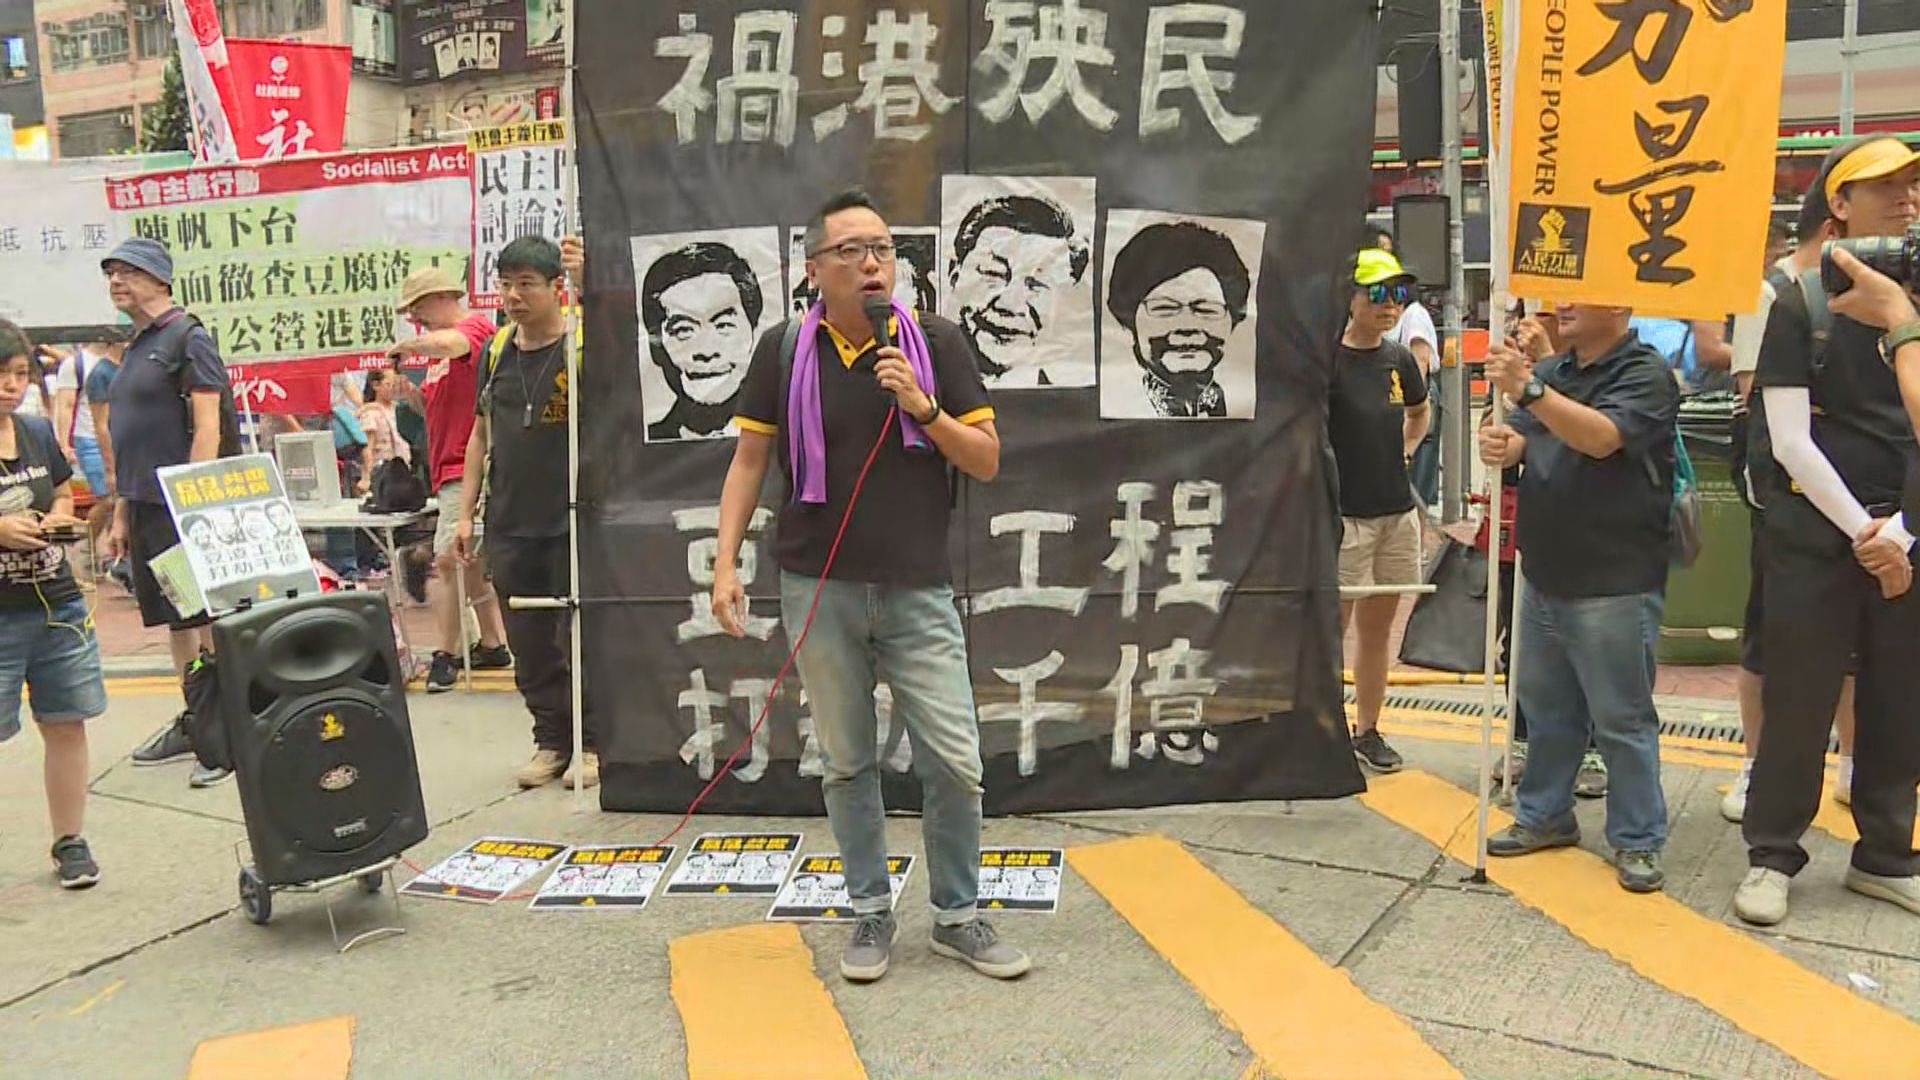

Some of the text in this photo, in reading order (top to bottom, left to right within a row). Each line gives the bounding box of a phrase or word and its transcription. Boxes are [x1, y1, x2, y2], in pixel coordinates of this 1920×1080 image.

[655, 0, 1261, 145] 禍港殃民
[474, 123, 565, 148] 社會主義行動
[1533, 90, 1561, 196] POWER
[114, 170, 260, 208] 社會主義行動
[322, 157, 420, 180] Socialist
[135, 206, 297, 251] 陳帆下台
[1519, 248, 1578, 270] 人民力量
[206, 304, 397, 355] 公營港鐵
[672, 481, 1233, 644] 豆工程
